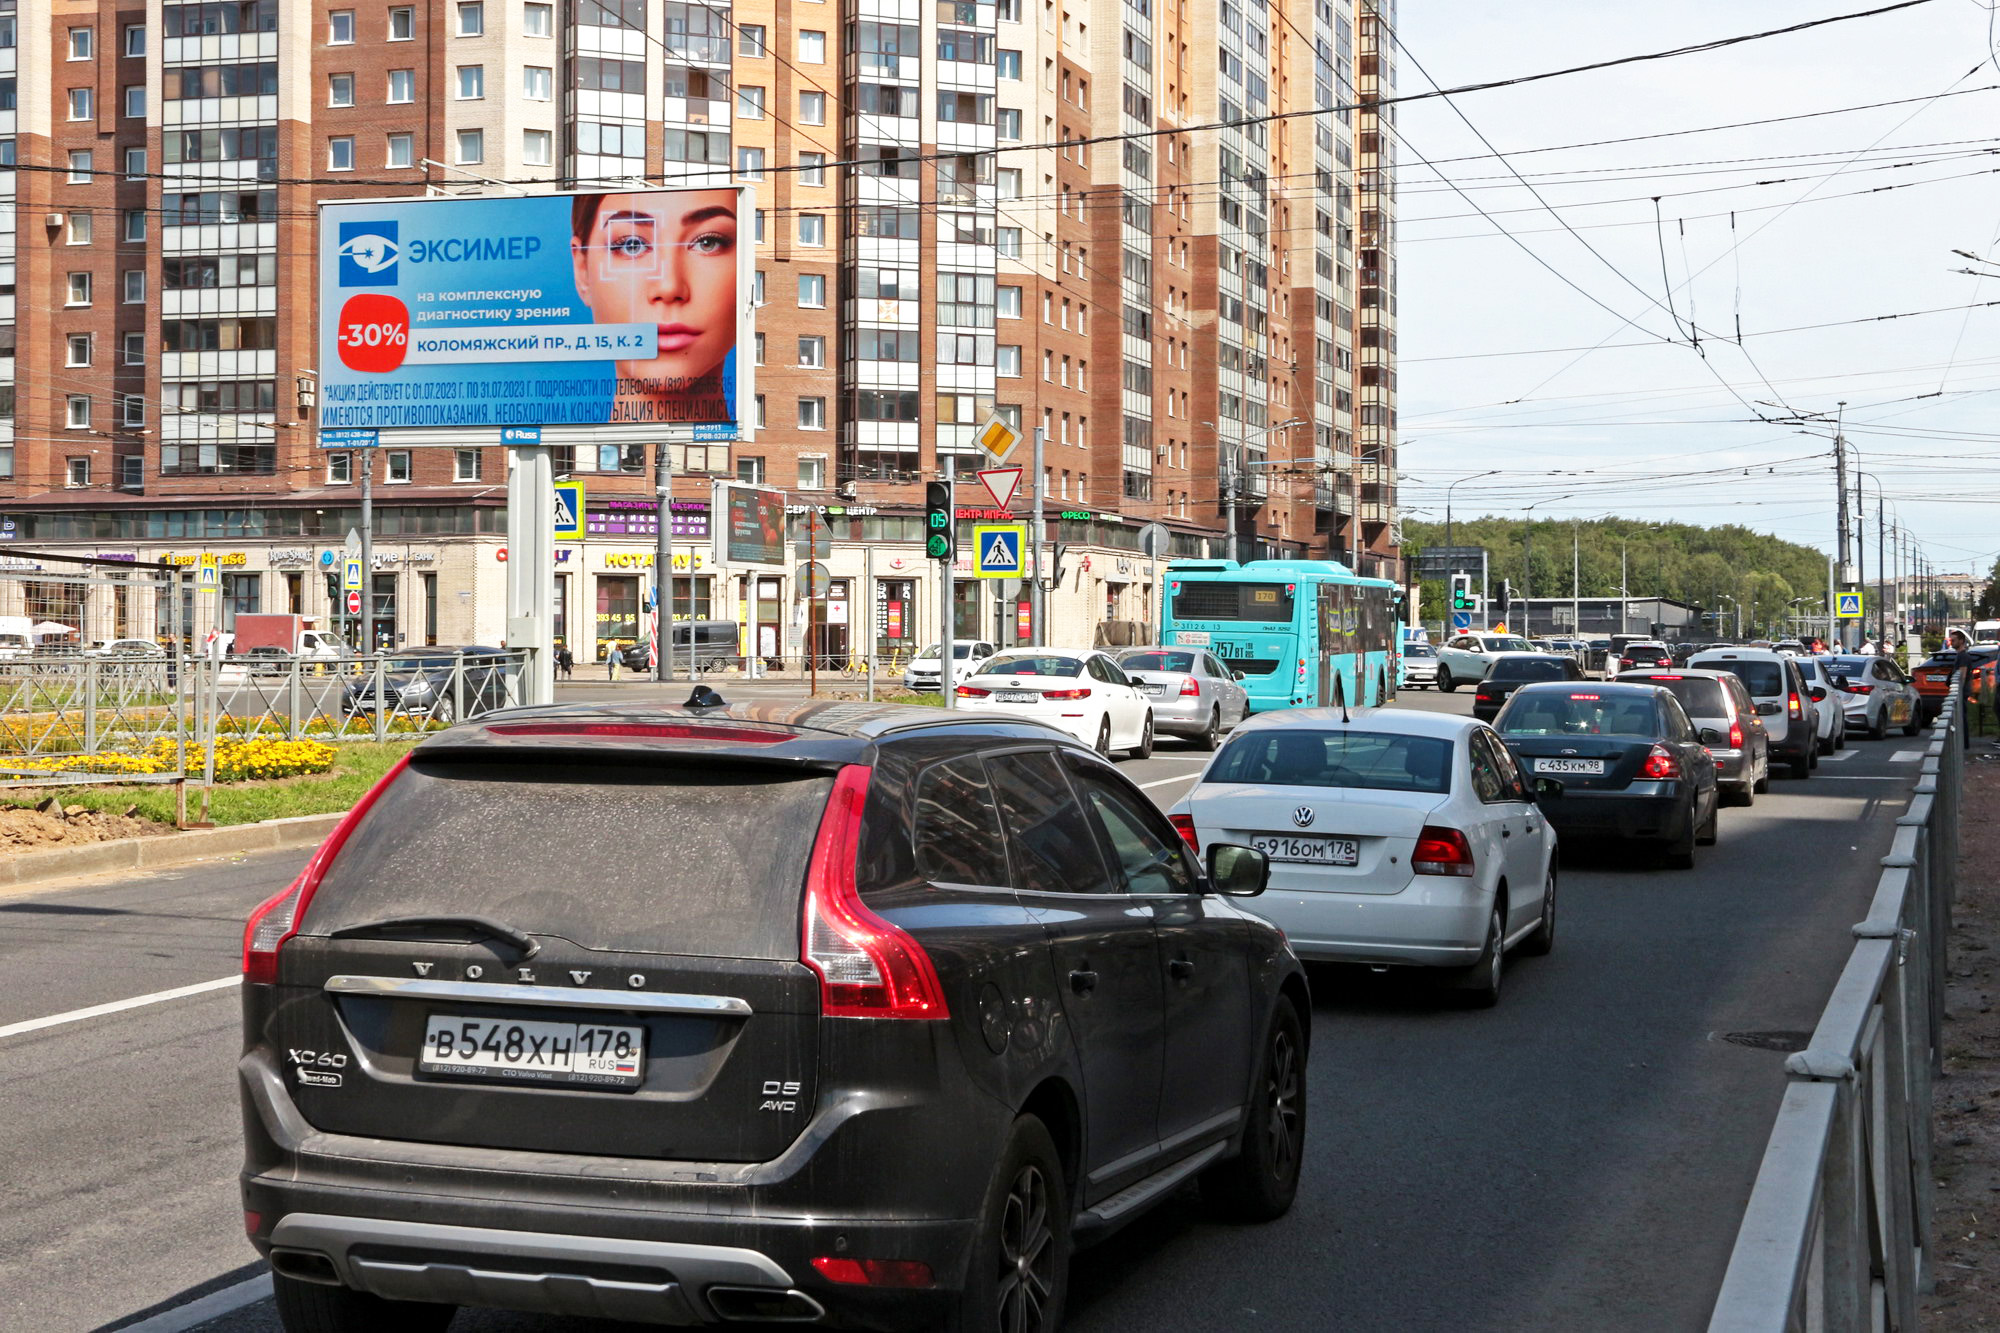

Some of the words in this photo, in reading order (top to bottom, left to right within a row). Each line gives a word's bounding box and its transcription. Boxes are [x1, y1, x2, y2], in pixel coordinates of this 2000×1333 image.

[408, 236, 542, 263] ЭКСИМЕР
[416, 292, 434, 302] на
[439, 288, 542, 303] комплексную
[416, 309, 513, 322] диагностику
[516, 306, 570, 319] зрения
[338, 323, 406, 347] -30%
[417, 335, 538, 352] КОЛОМЯЖСКИЙ
[543, 337, 572, 350] ПР.,
[576, 336, 591, 350] Д.
[595, 336, 612, 350] 15,
[617, 336, 631, 348] К.
[634, 336, 643, 347] 2
[357, 381, 404, 402] ДЕЙСТВУЕТ
[405, 383, 411, 399] С
[412, 382, 457, 399] 01.07.2023
[459, 382, 465, 399] Г.
[467, 381, 479, 399] ПО
[480, 380, 525, 399] 31.07.2023
[525, 380, 533, 397] Г.
[535, 378, 599, 398] ПОДРОБНОСТИ
[600, 378, 612, 396] ПО
[615, 376, 663, 396] ТЕЛЕФОНУ:
[664, 376, 686, 395] (812)
[322, 404, 373, 426] ИМЕЮТСЯ
[376, 403, 491, 425] ПРОТИВОПОКАЗАНИЯ.
[495, 401, 568, 424] НЕОБХОДИМА
[570, 400, 653, 423] КОНСУЛЬТАЦИЯ
[515, 430, 537, 439] Russ
[609, 501, 650, 509] МАГАЗИН
[653, 502, 705, 510] КМЕТИКИ
[846, 506, 877, 515] ЦЕНТР
[598, 514, 707, 523] ПАРИКМЕРОВ
[931, 513, 946, 528] 05
[1068, 512, 1091, 520] РЕСО
[628, 525, 705, 533] МАСРОВ
[414, 553, 435, 561] БАНК
[605, 553, 702, 568] НОТАИУС
[611, 613, 622, 622] 45
[1181, 622, 1206, 630] 31126
[1539, 760, 1586, 771] С435КМ
[1588, 761, 1600, 769] 98
[1257, 838, 1324, 857] Р916ОМ
[1327, 841, 1353, 855] 178
[413, 961, 646, 989] VOLVO
[435, 1023, 572, 1066] В548ХН
[580, 1028, 631, 1059] 178
[432, 1064, 451, 1074] (812)
[452, 1065, 487, 1075] 920-89-72
[589, 1059, 615, 1070] RUS
[502, 1069, 517, 1077] СТО
[517, 1070, 535, 1078] Volvo
[568, 1073, 588, 1082] (812)
[588, 1074, 626, 1085] 920-89-72
[762, 1081, 801, 1095] D5
[759, 1100, 797, 1112] AWD
